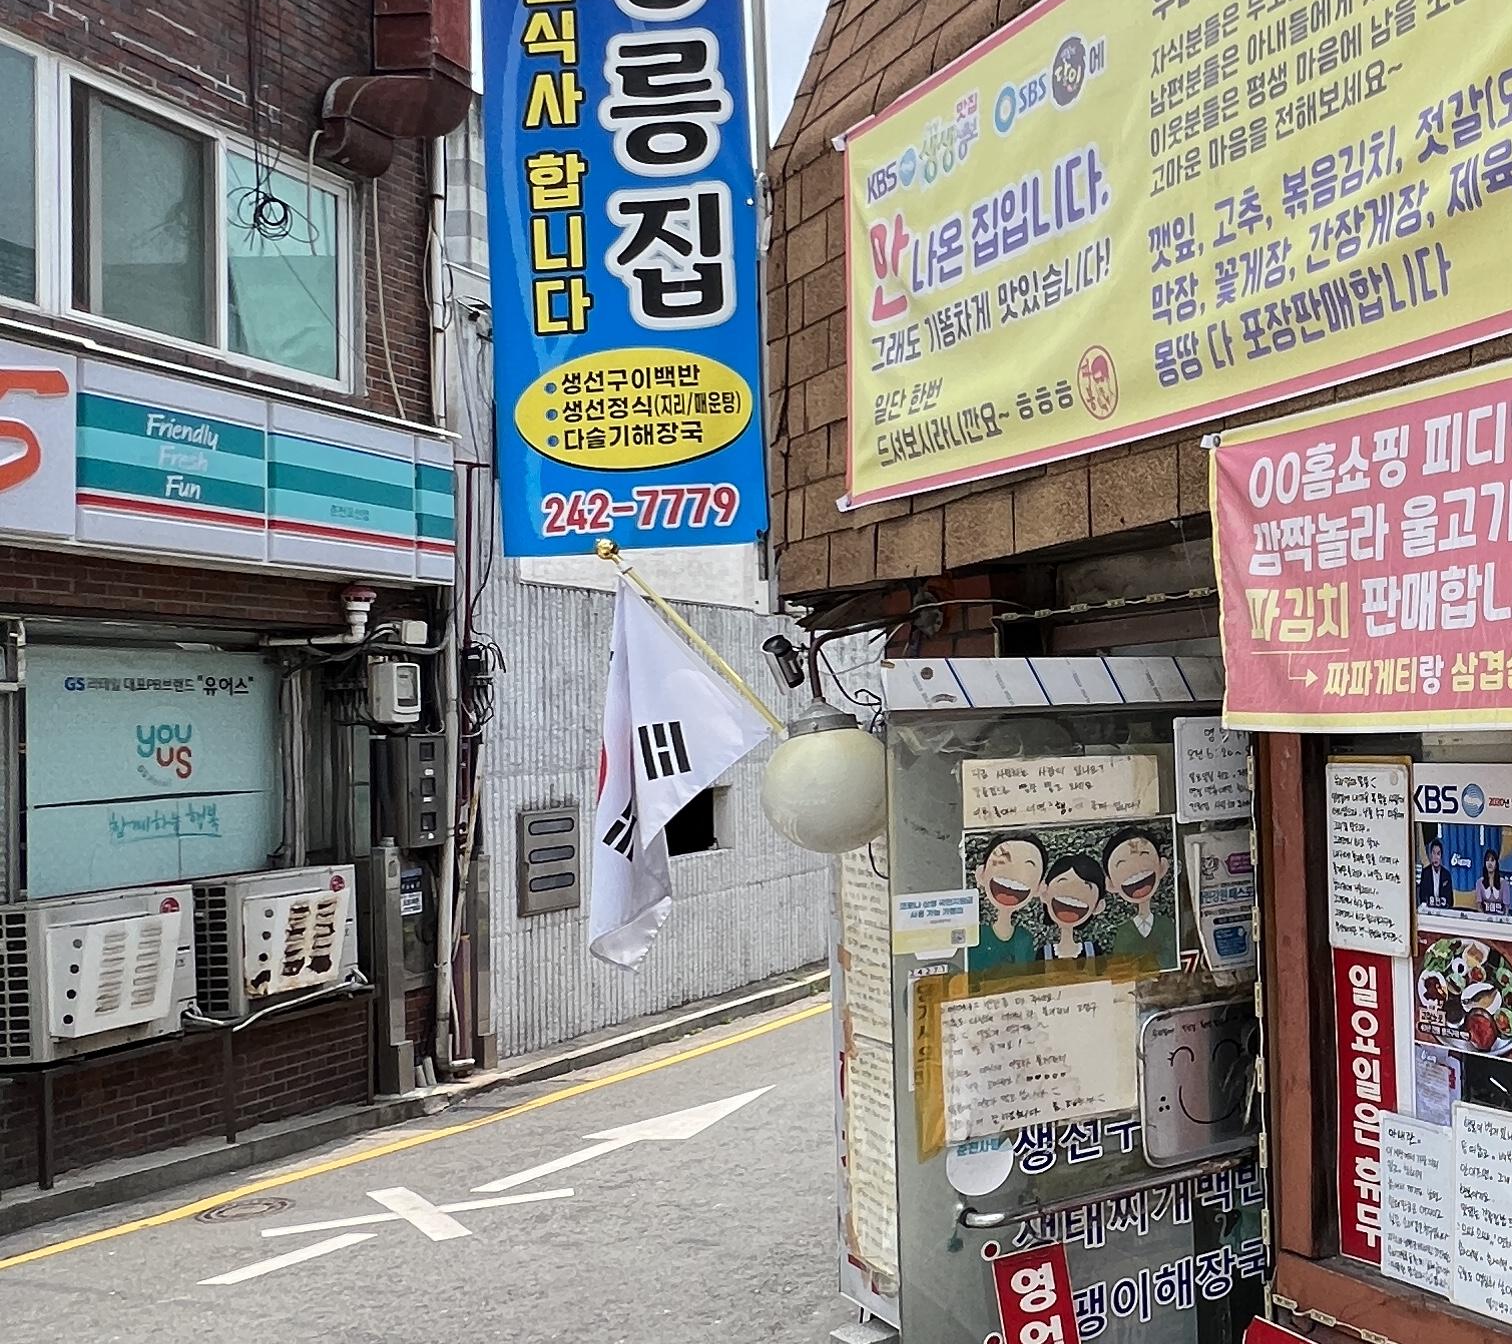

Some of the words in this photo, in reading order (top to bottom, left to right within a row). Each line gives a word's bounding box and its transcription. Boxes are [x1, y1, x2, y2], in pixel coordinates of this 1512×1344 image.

[1089, 40, 1105, 74] 에
[1151, 2, 1240, 78] 자식분들은
[1018, 73, 1047, 114] SBS
[1150, 44, 1239, 118] 남편분들은
[1150, 86, 1239, 157] 이웃분들은
[1247, 61, 1287, 109] 평생
[1297, 22, 1362, 85] 마음에
[867, 161, 897, 204] KBS
[1150, 146, 1201, 198] 고마운
[1209, 116, 1268, 170] 마음을
[1149, 212, 1204, 273] 깻잎,
[1213, 185, 1272, 248] 고추,
[1282, 124, 1403, 220] 볶음김치,
[526, 151, 592, 334] 합니다
[869, 214, 909, 322] 안
[913, 218, 964, 293] 나온
[972, 149, 1109, 268] 집입니다.
[1152, 272, 1206, 325] 막장,
[1214, 236, 1296, 306] 꽃게장,
[1306, 179, 1434, 275] 간장게장,
[871, 324, 921, 373] 그래도
[924, 295, 990, 350] 기똥차게
[997, 240, 1112, 321] 맛있습니다!
[1154, 330, 1202, 388] 몽땅
[1207, 319, 1235, 370] 다
[1240, 242, 1452, 359] 포장판매합니다
[560, 363, 700, 393] 생선구이백반
[875, 387, 906, 425] 일단
[909, 377, 943, 411] 한번
[145, 413, 219, 451] Friendly
[562, 422, 703, 451] 다슬기해장국
[165, 474, 201, 500] Fun
[541, 483, 737, 538] 242-7779
[1252, 501, 1389, 579] 깜짝놀라
[1245, 581, 1350, 645] 파김치
[1323, 653, 1446, 698] 짜파게티랑
[136, 724, 192, 758] you
